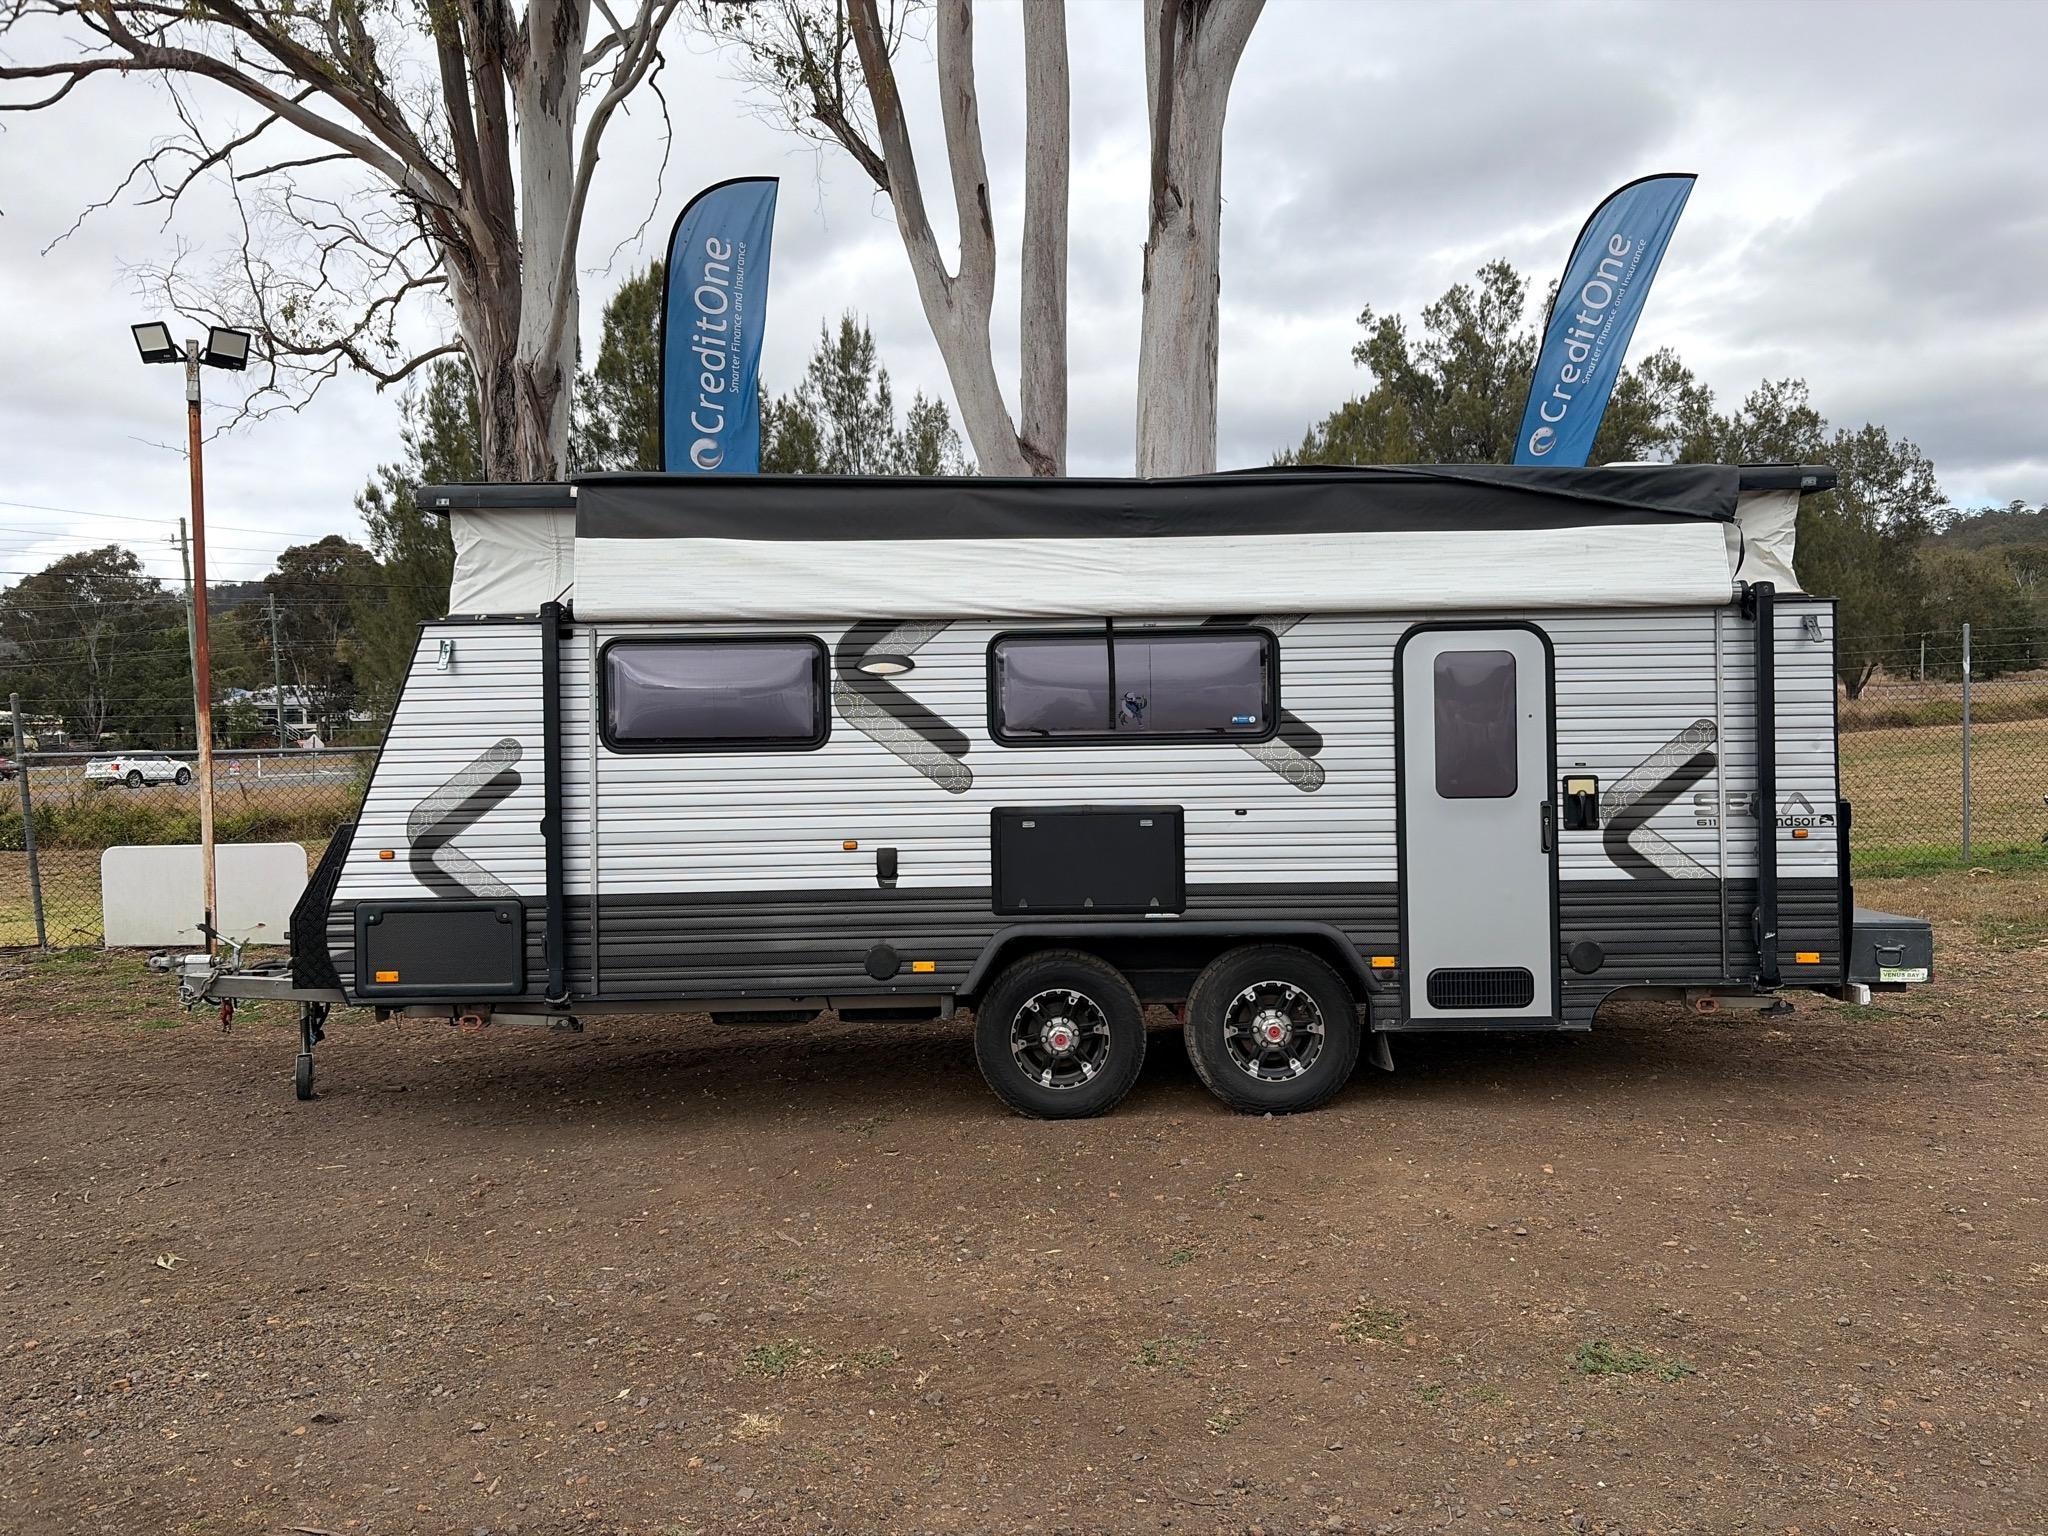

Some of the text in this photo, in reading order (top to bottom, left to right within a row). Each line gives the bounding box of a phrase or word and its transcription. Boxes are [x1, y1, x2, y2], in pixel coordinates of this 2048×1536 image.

[690, 237, 732, 434] CreditOne
[729, 241, 747, 393] Smarter Finance and Insurance
[1540, 232, 1631, 423] CreditOne
[1581, 239, 1648, 385] Smarter Finance and Insurance
[1694, 791, 1815, 816] SEA
